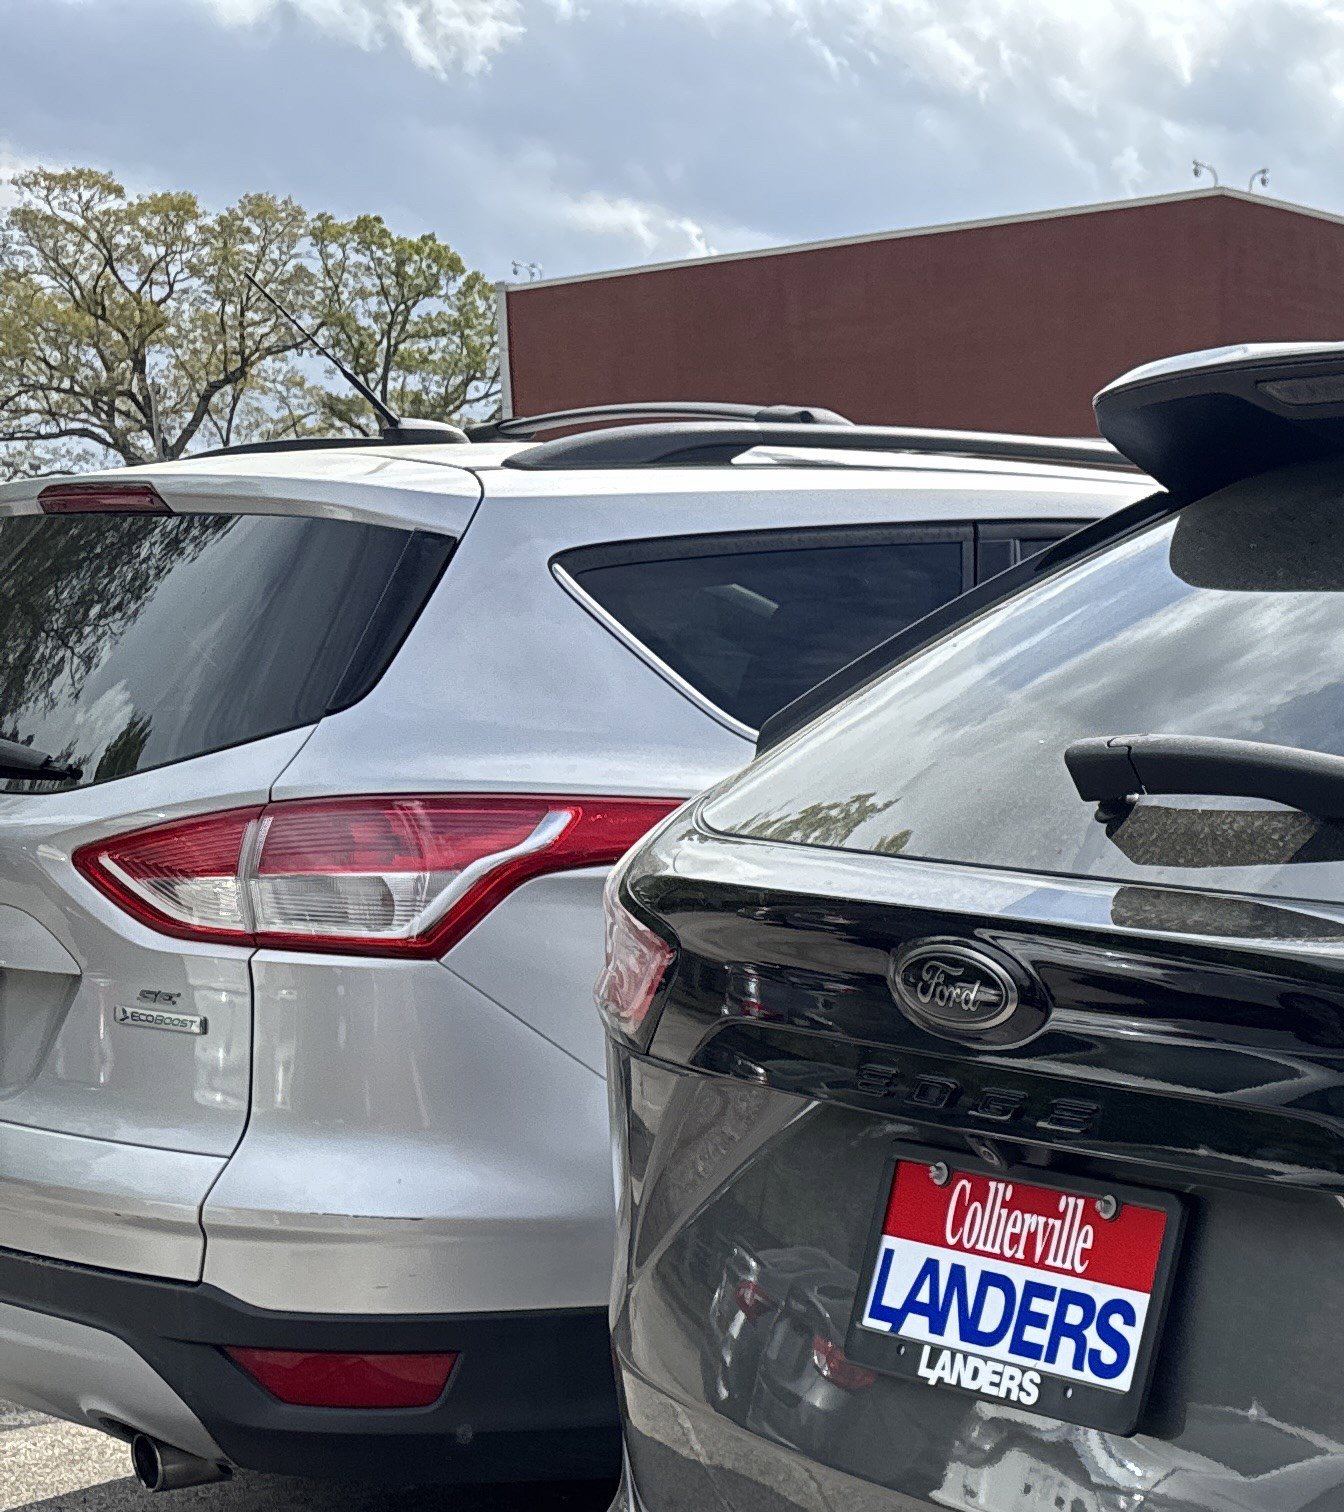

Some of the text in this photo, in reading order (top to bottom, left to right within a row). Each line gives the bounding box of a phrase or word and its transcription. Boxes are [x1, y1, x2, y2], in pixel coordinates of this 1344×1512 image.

[915, 960, 984, 1013] Ford
[130, 1010, 198, 1029] ECOBOOST
[944, 1178, 1095, 1274] Collierville
[867, 1247, 1137, 1381] LANDERS
[917, 1344, 1041, 1406] LANDERS
